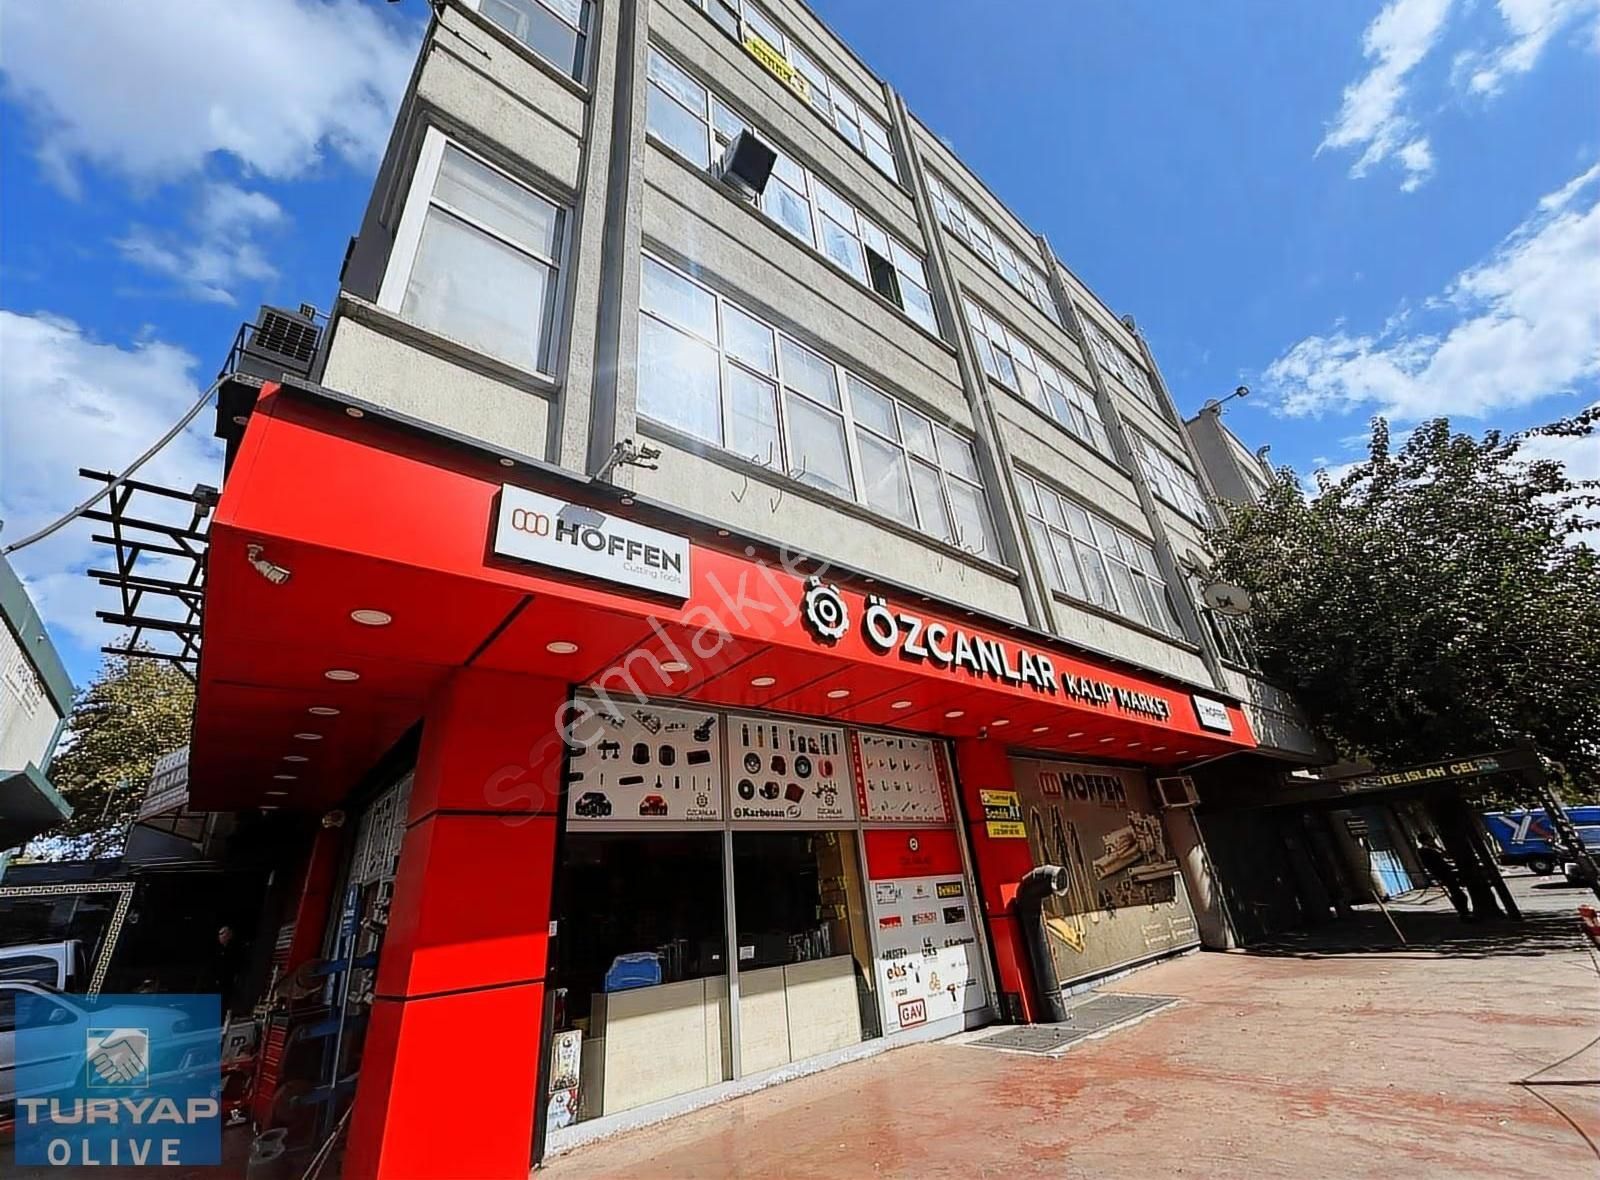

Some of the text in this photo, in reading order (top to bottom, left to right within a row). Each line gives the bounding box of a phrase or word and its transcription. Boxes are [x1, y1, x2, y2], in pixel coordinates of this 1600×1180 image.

[555, 519, 682, 574] HOFFEN
[623, 562, 682, 584] Cutting Tools
[863, 594, 1172, 719] ÖZCANLAR KALIP MARKET
[742, 807, 785, 818] Karbosan
[902, 1004, 923, 1021] GAV
